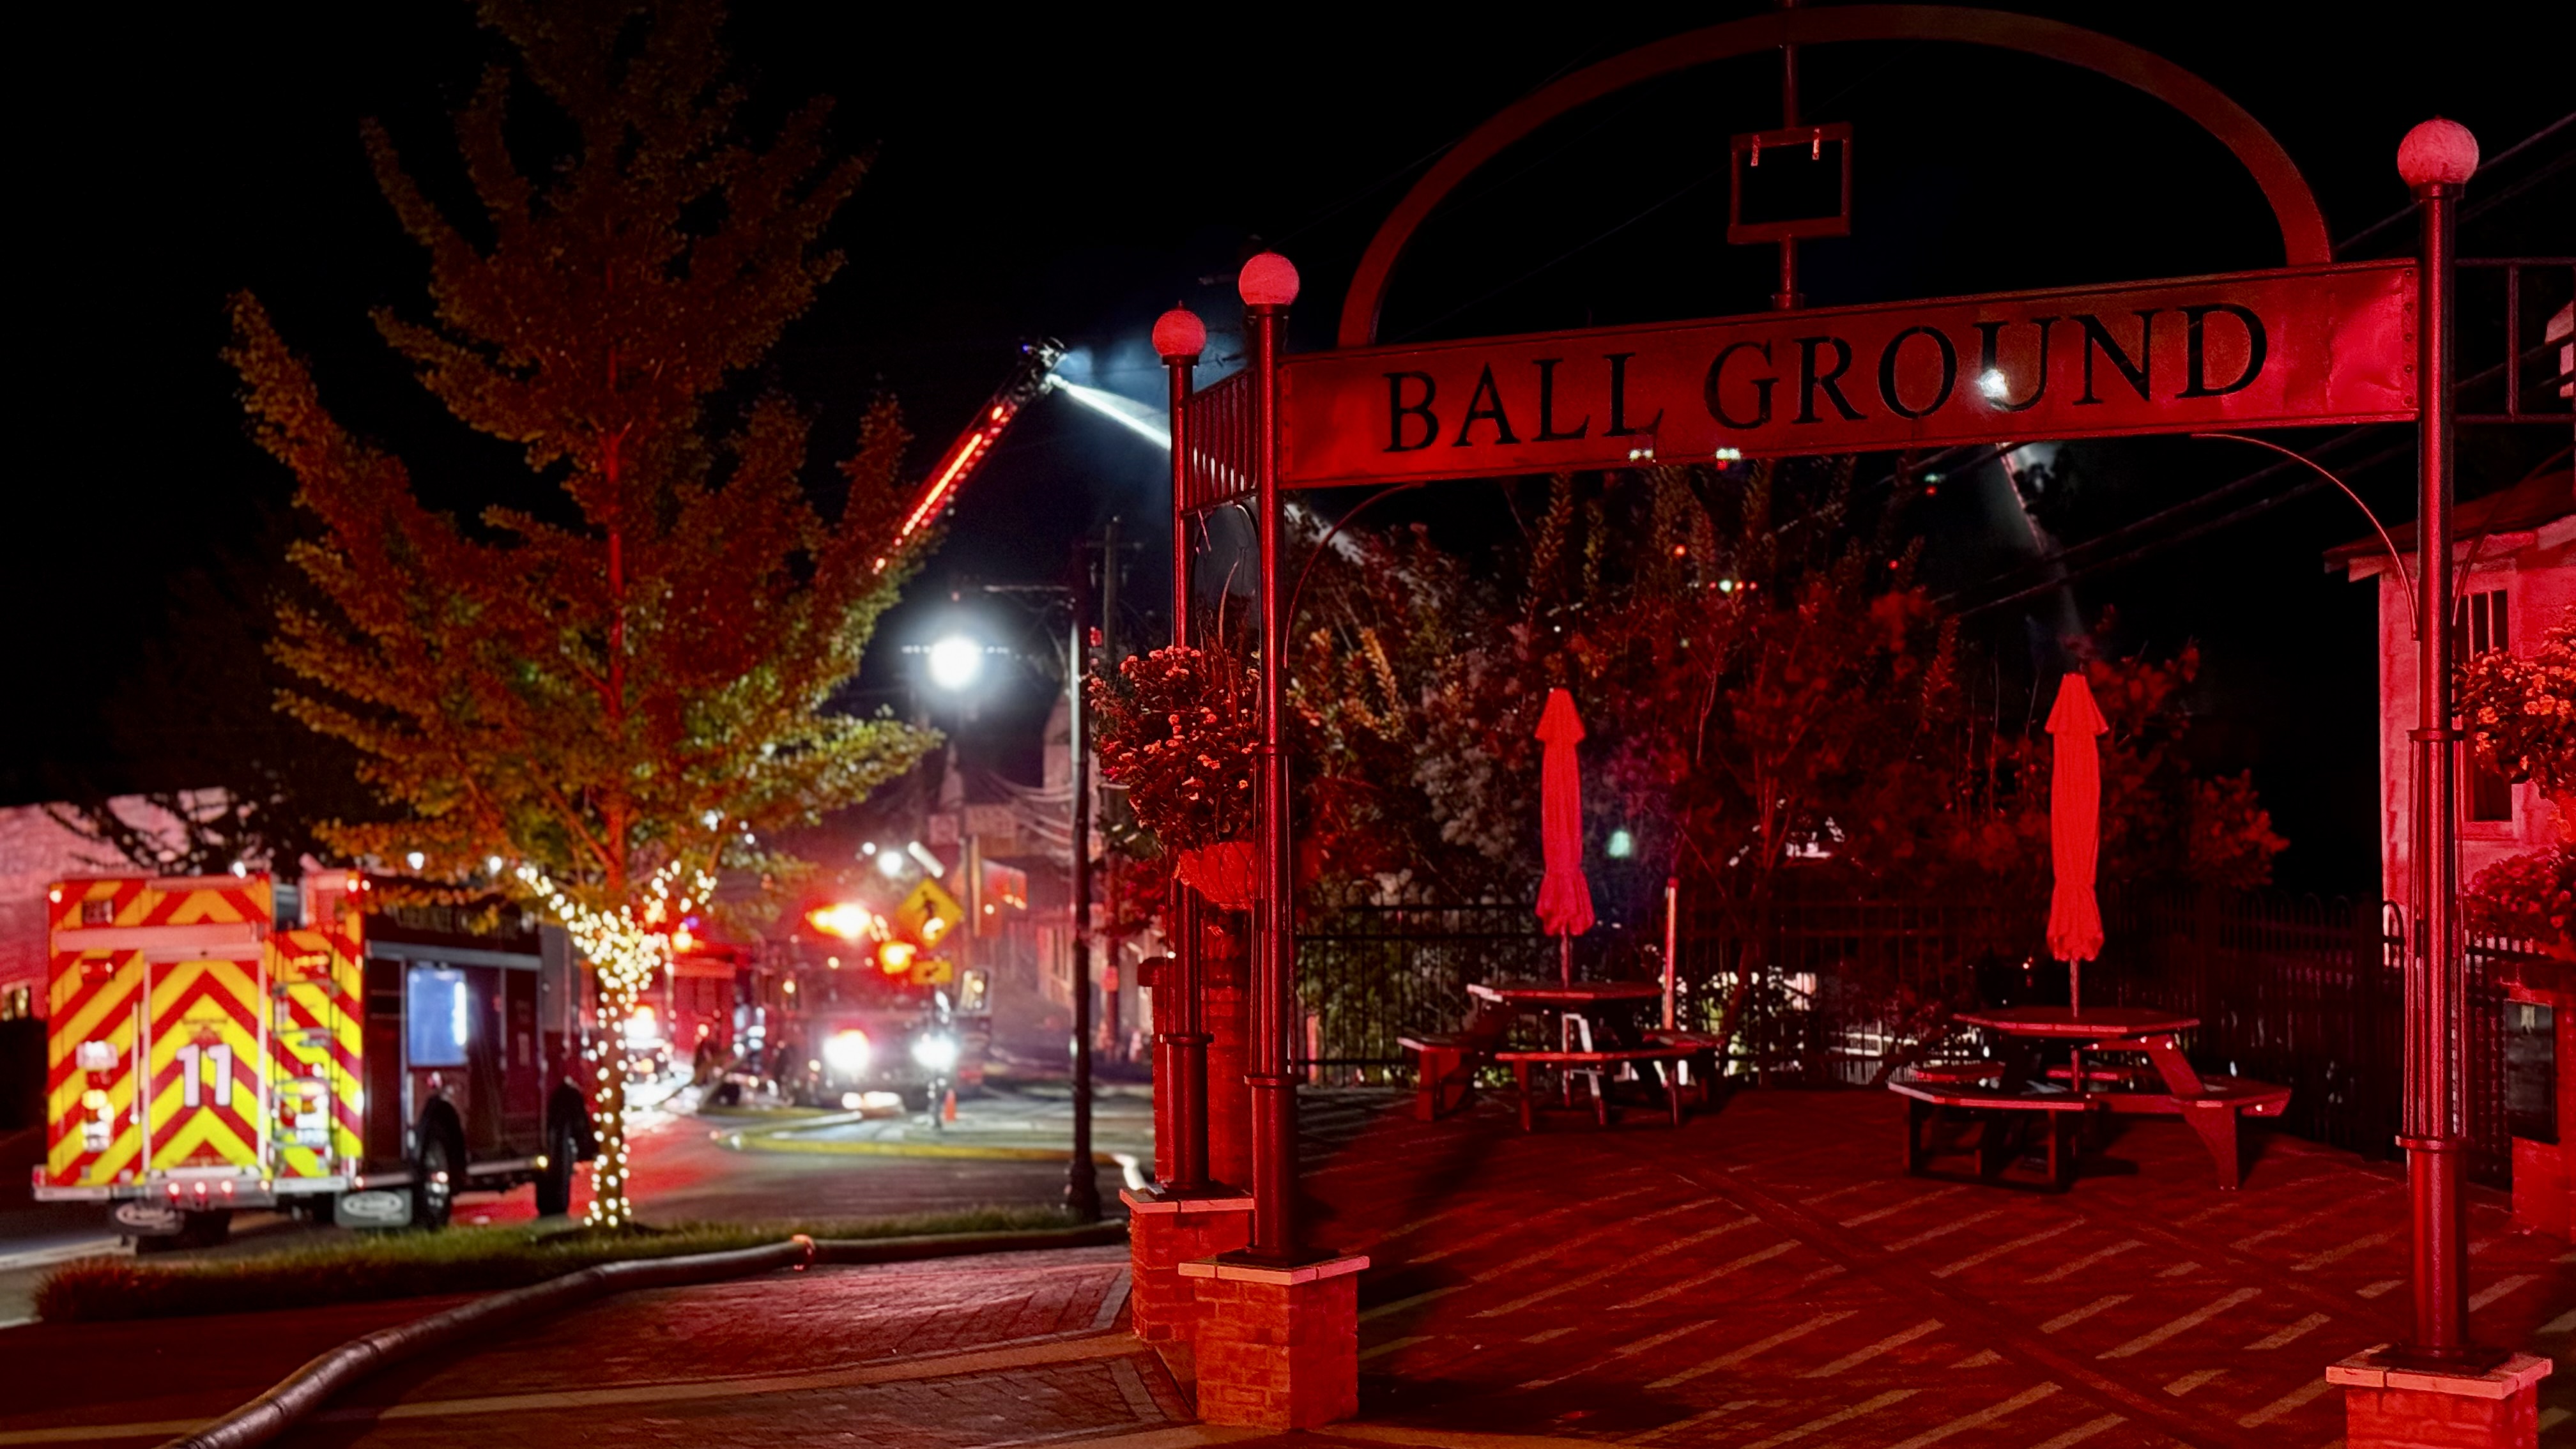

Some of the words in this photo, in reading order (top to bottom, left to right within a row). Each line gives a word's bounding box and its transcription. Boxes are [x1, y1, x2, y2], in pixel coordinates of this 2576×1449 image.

[1383, 352, 1664, 452] BALL
[1703, 302, 2269, 430] GROUND
[176, 1043, 233, 1108] 11
